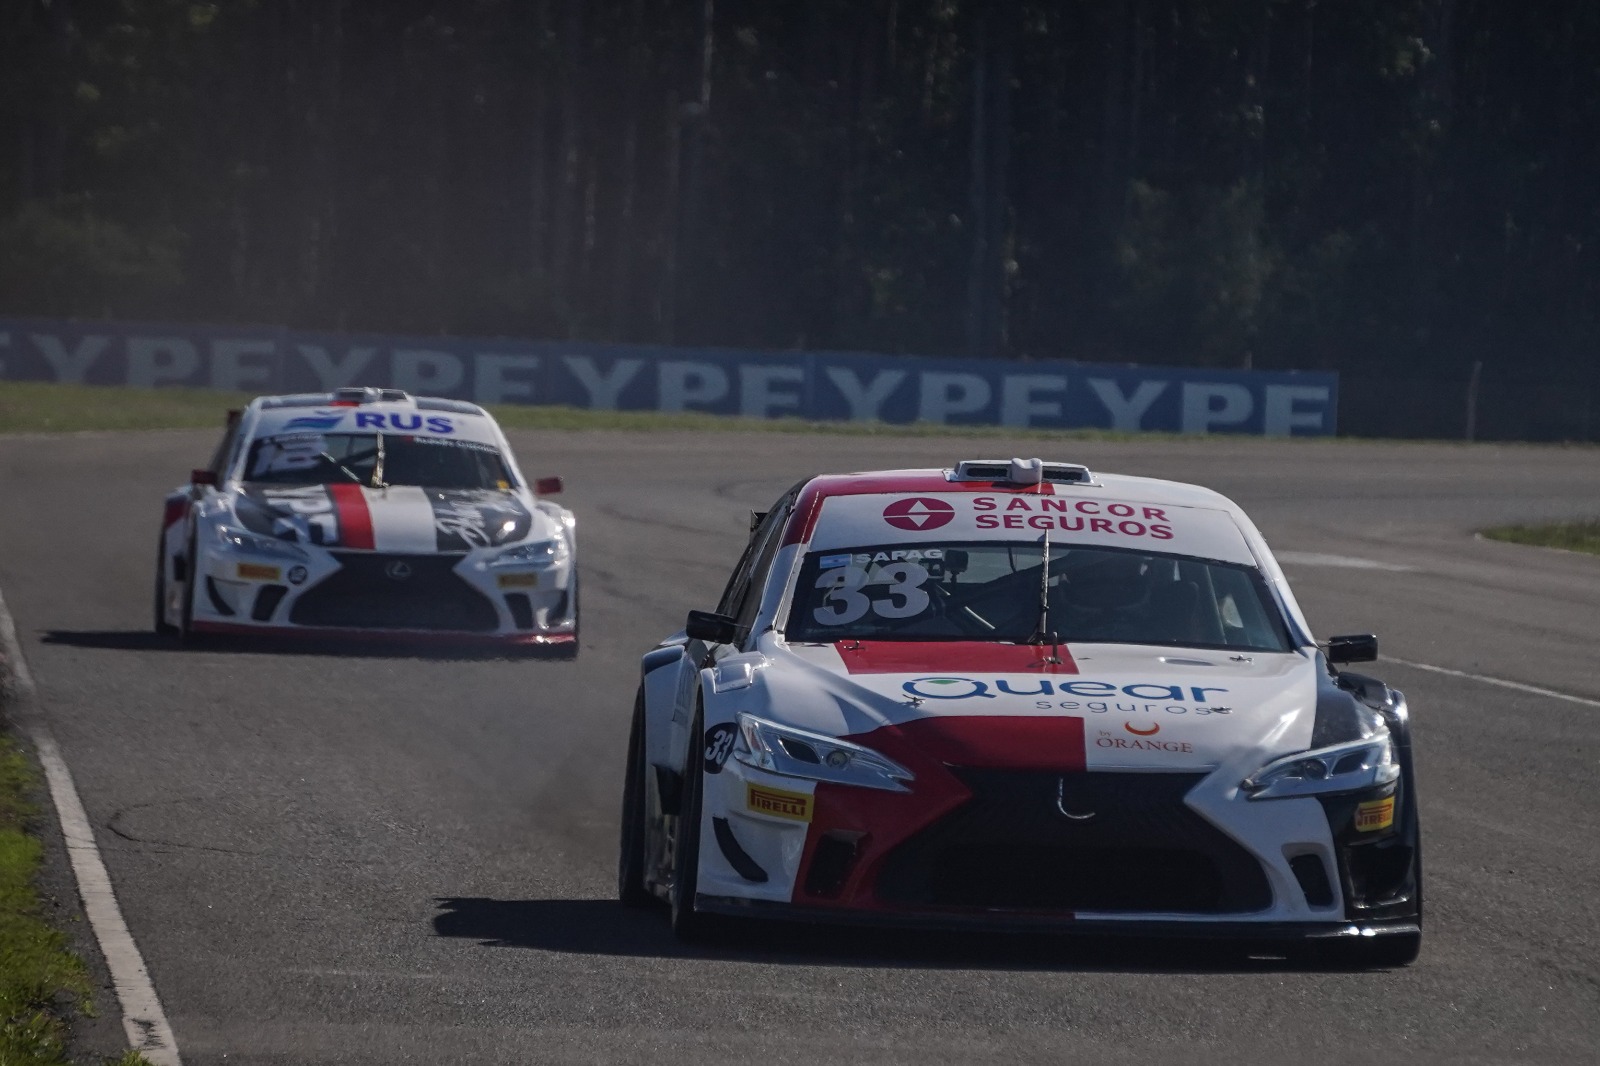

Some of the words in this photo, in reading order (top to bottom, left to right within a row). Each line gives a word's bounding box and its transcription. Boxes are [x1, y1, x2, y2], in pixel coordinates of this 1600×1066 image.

[355, 411, 455, 435] RUS
[972, 497, 1170, 522] SANCOR
[976, 514, 1174, 540] SEGUROS
[855, 549, 943, 563] SAPAG
[813, 562, 930, 626] 33
[902, 676, 1229, 704] Quear
[1036, 701, 1212, 715] seguros
[1096, 737, 1193, 754] ORANGE
[1099, 730, 1112, 738] by
[704, 729, 734, 765] 33
[750, 788, 807, 816] PIRELLI
